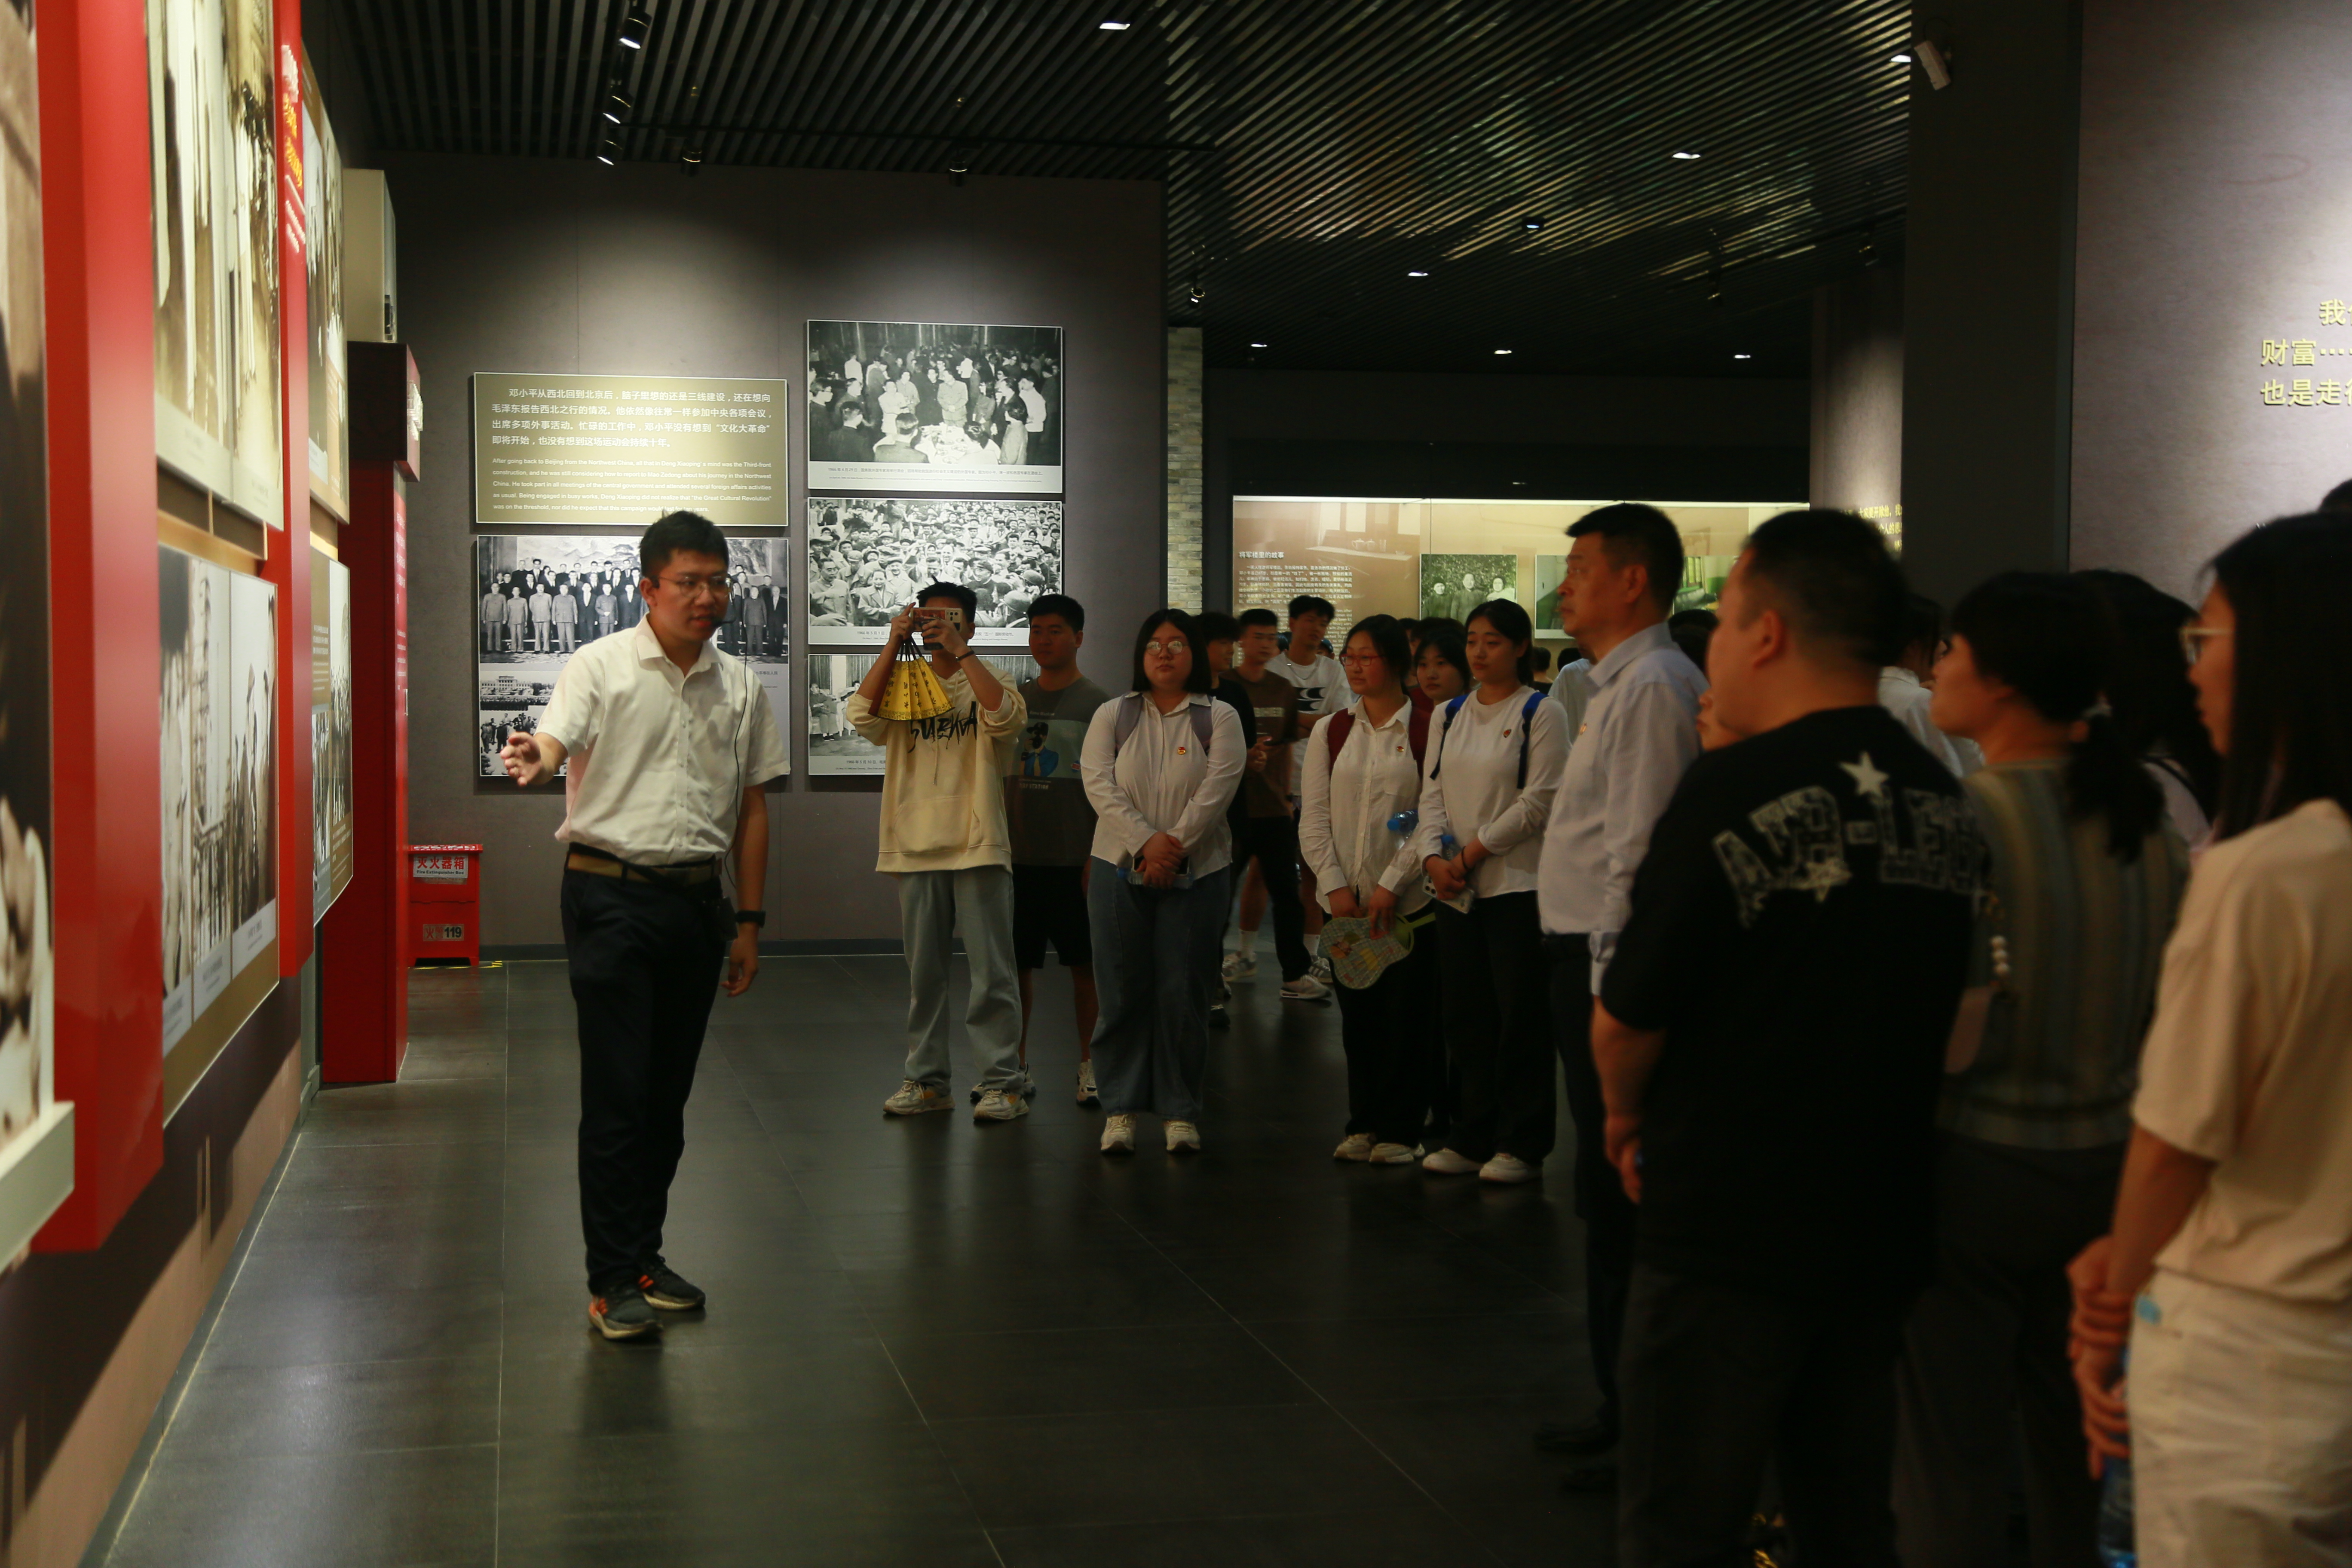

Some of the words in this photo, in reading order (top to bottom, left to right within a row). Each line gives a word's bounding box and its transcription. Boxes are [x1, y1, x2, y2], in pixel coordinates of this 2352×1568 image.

[2319, 298, 2352, 325] 我
[417, 856, 465, 870] 灭火器箱
[444, 926, 462, 938] 119
